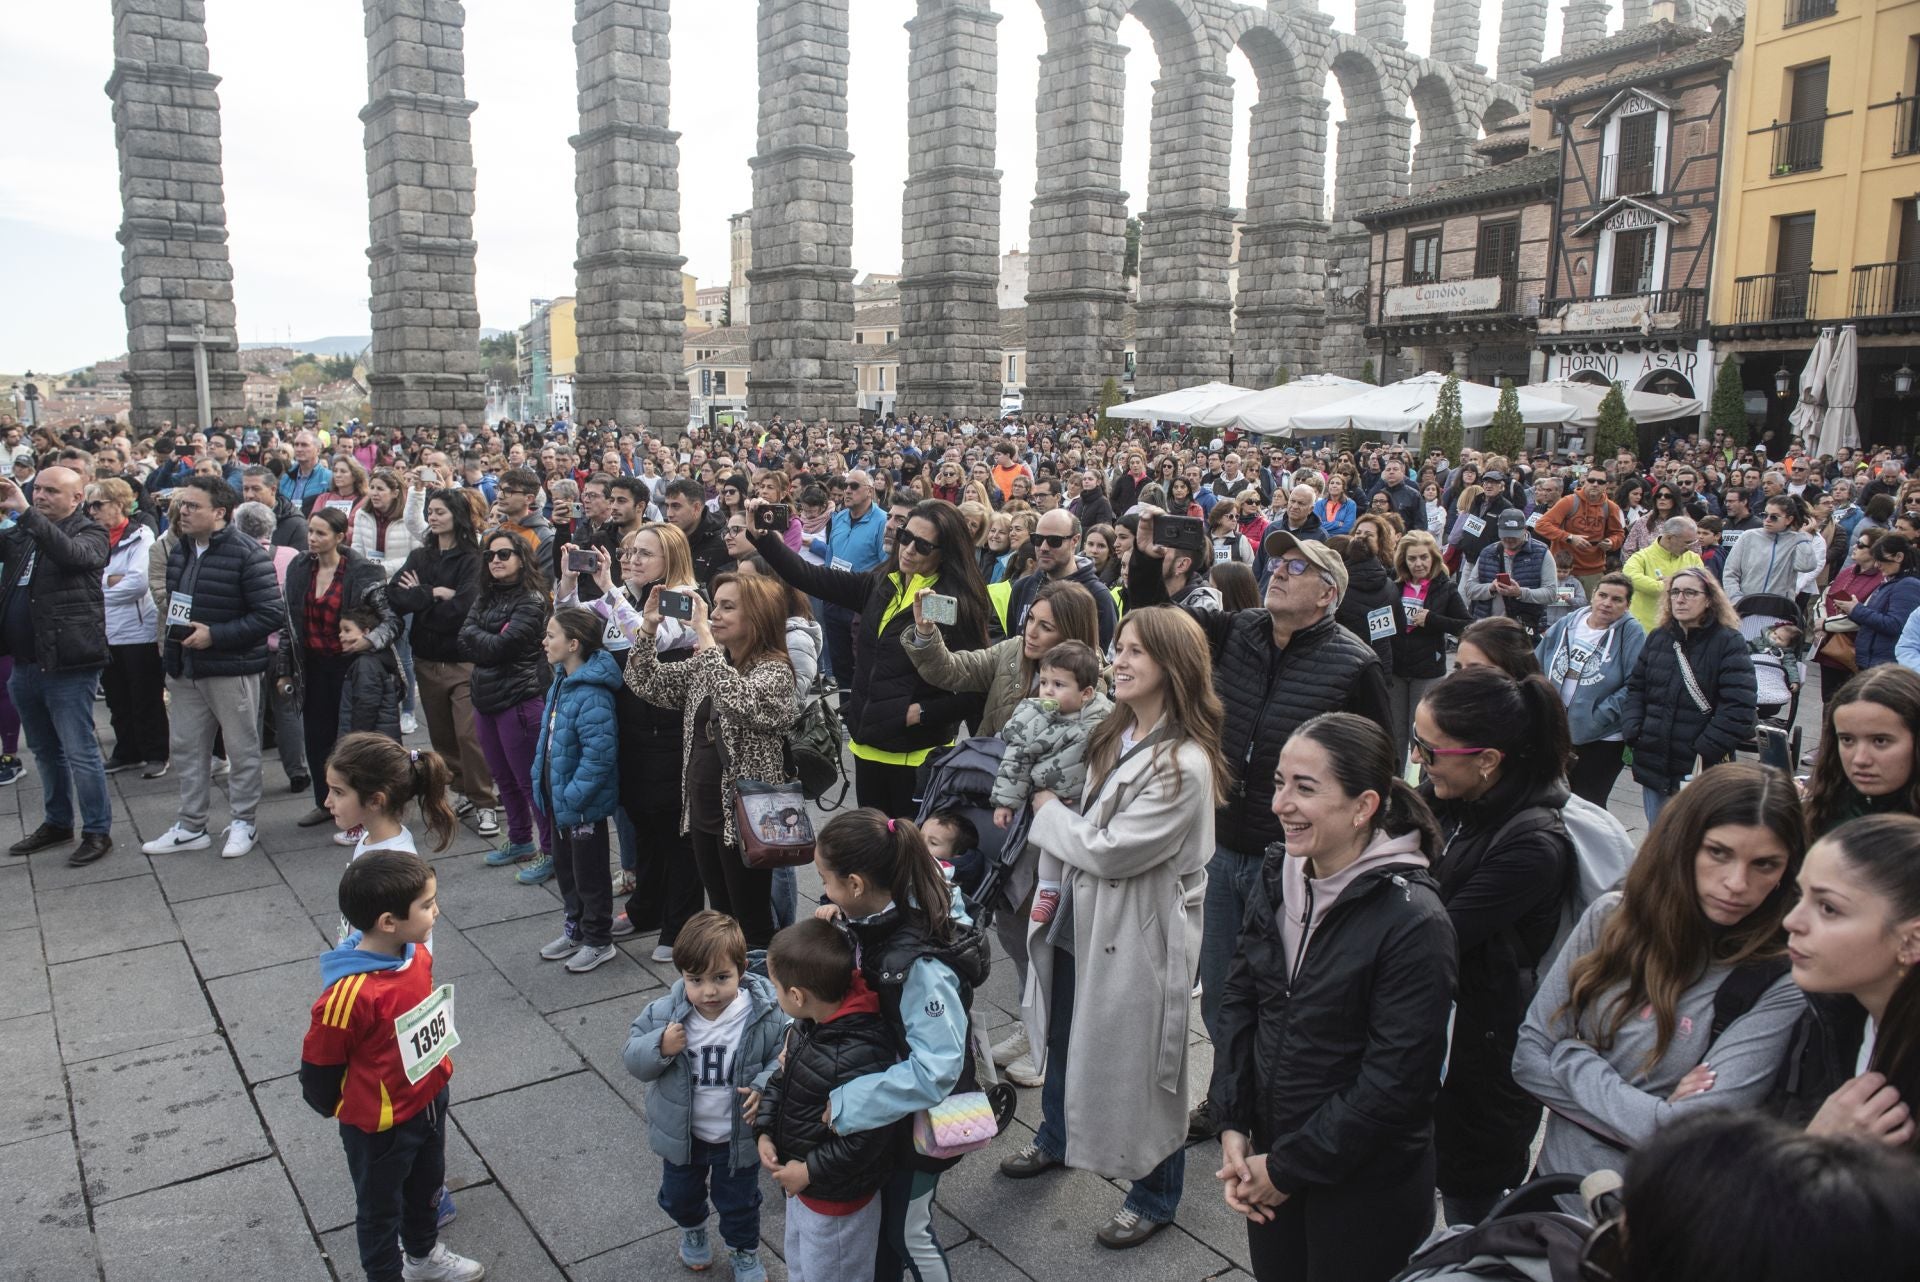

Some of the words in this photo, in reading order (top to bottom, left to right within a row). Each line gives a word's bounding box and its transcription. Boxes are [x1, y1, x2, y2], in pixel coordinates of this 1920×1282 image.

[1605, 213, 1625, 230] CASA
[1559, 354, 1618, 381] HORNO
[1640, 352, 1698, 388] ASAR
[171, 603, 191, 620] 678
[1404, 606, 1418, 617] 70
[1370, 616, 1390, 631] 513
[410, 1010, 446, 1060] 1395
